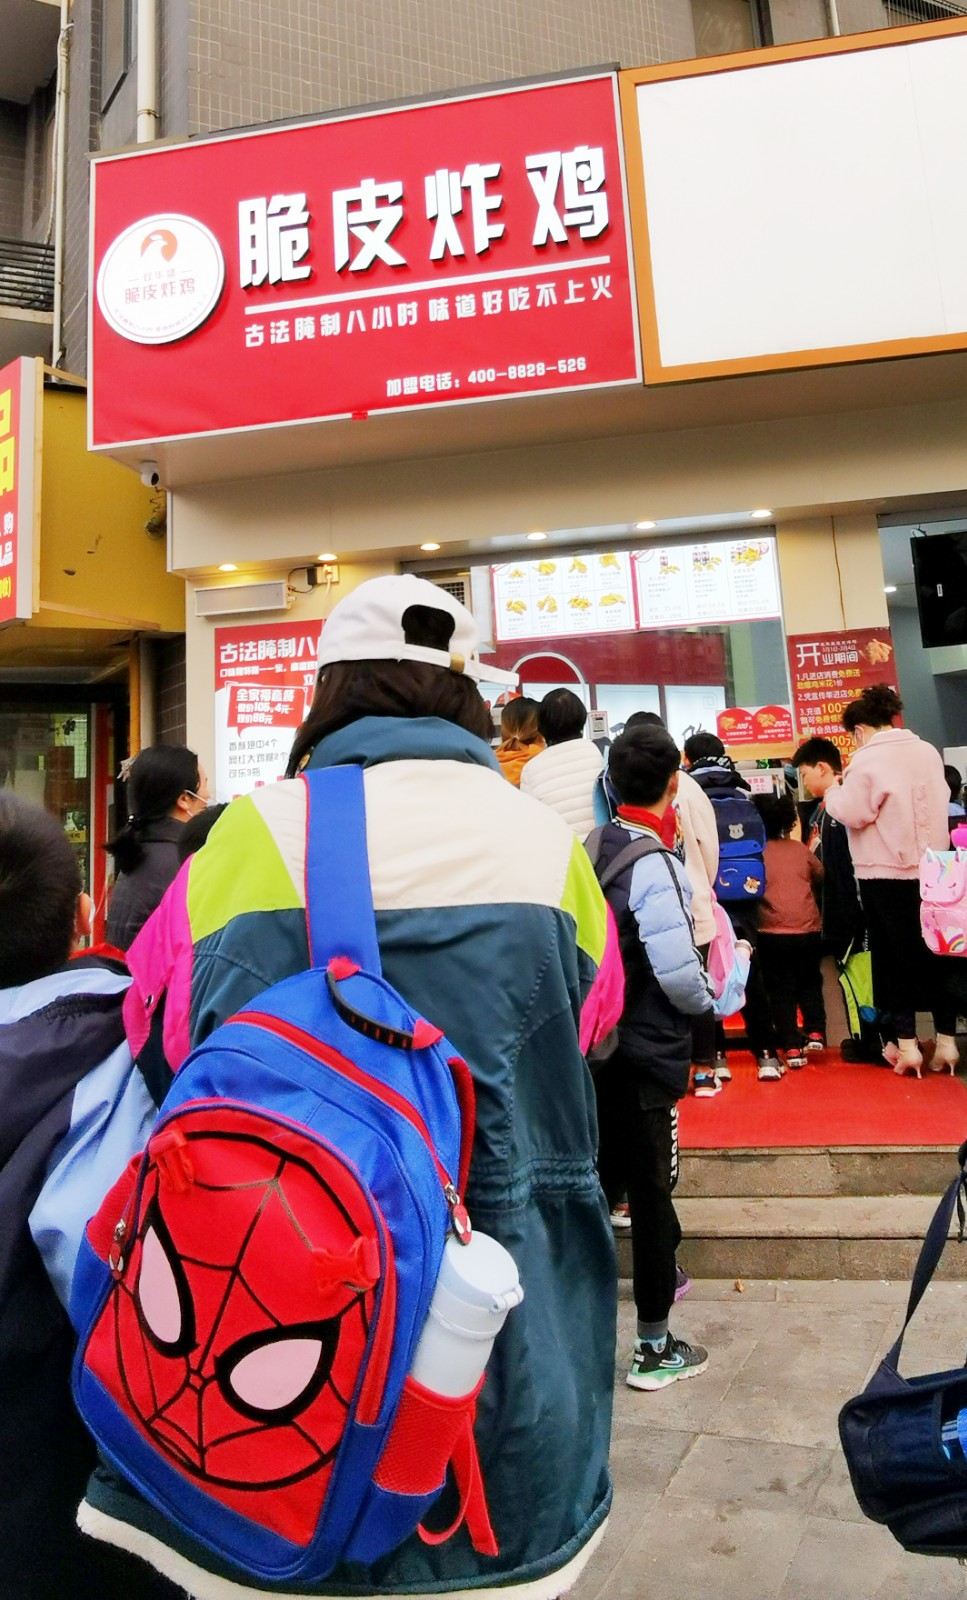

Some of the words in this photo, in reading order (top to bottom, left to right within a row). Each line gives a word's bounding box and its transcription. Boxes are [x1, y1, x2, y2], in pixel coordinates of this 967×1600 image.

[238, 145, 609, 289] 脆皮炸鸡
[124, 278, 195, 304] 脆皮炸鸡
[244, 302, 418, 347] 古法腌制八小时
[429, 275, 612, 322] 味道好吃不上火
[220, 636, 320, 664] 古法腌制八
[796, 642, 821, 668] 开
[821, 651, 859, 665] 业期间
[798, 688, 864, 701] 2.凭宣传单进店免费
